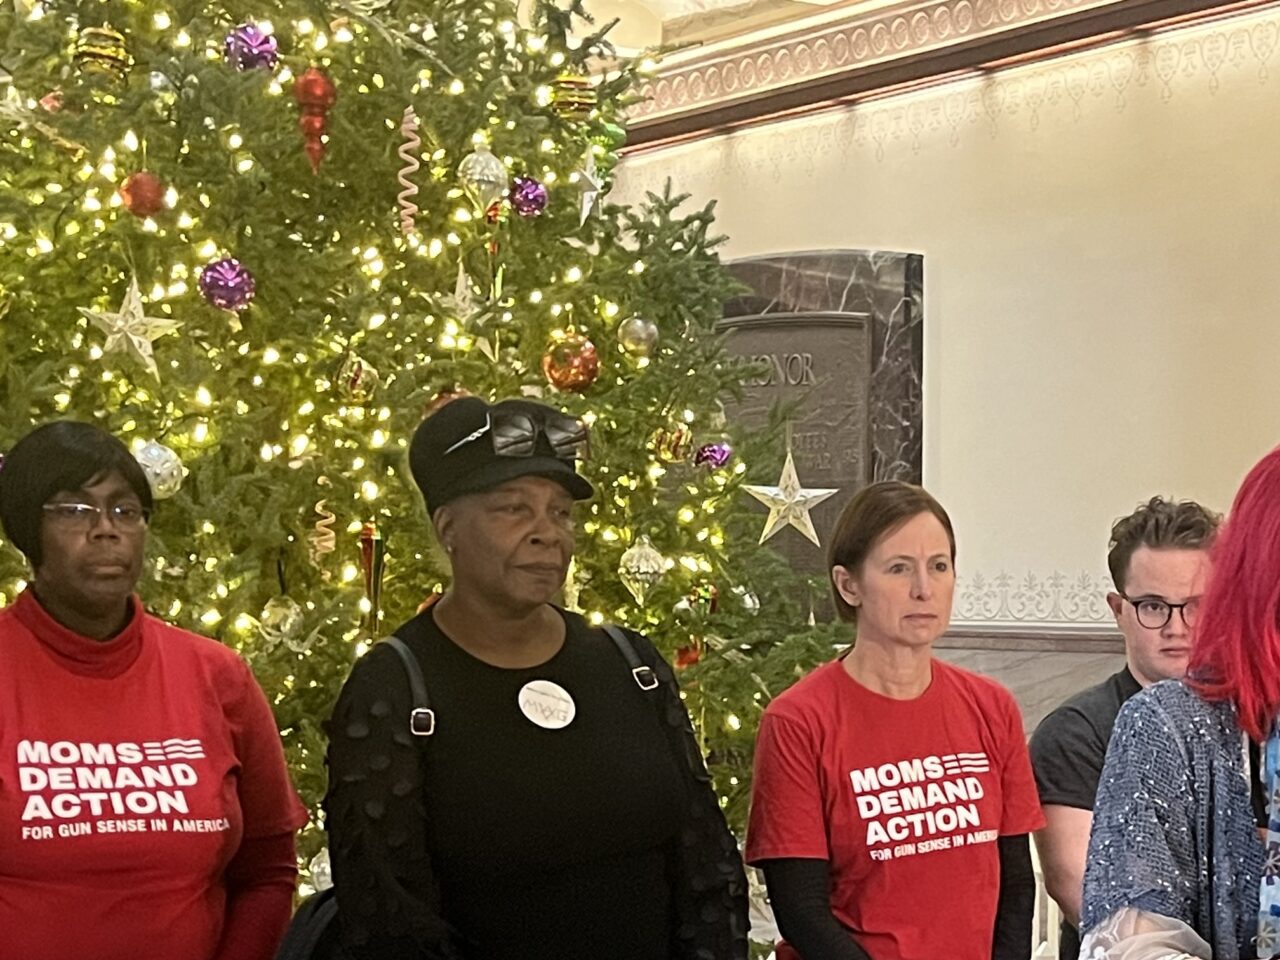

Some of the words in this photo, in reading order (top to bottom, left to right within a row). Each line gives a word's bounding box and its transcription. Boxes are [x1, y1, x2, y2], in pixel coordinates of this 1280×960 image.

[17, 740, 144, 765] MOMS
[18, 763, 198, 792] DEMAND
[850, 756, 945, 793] MOMS
[21, 790, 190, 821] ACTION
[856, 777, 984, 819] DEMAND
[22, 826, 54, 840] FOR
[58, 822, 92, 837] GUN
[96, 819, 147, 833] SENSE
[150, 819, 168, 832] IN
[173, 818, 230, 833] AMERICA
[866, 804, 980, 845] ACTION
[870, 848, 892, 861] FOR
[894, 843, 917, 857] GUN
[917, 838, 951, 854] SENSE
[953, 835, 965, 847] IN
